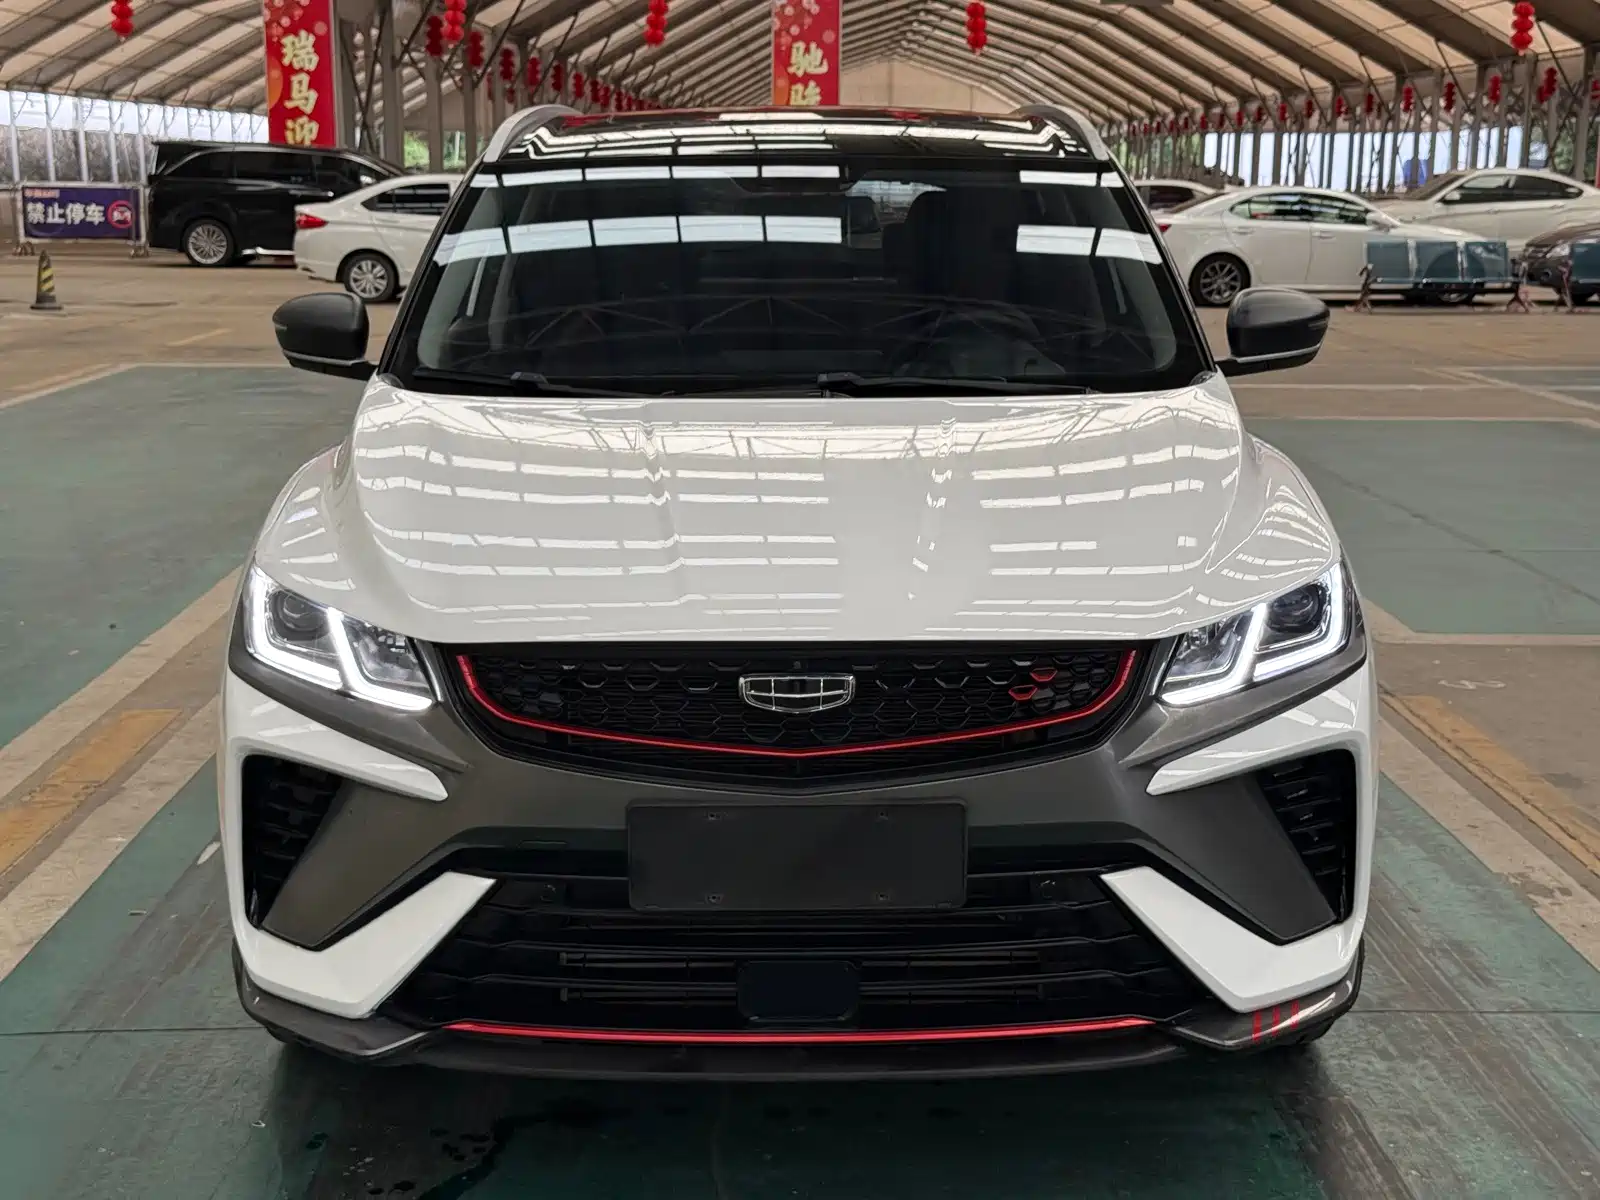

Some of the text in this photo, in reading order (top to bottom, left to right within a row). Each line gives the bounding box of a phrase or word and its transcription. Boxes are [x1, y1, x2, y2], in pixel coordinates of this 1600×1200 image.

[281, 29, 319, 147] 瑞马迎
[26, 202, 105, 225] 禁止停车
